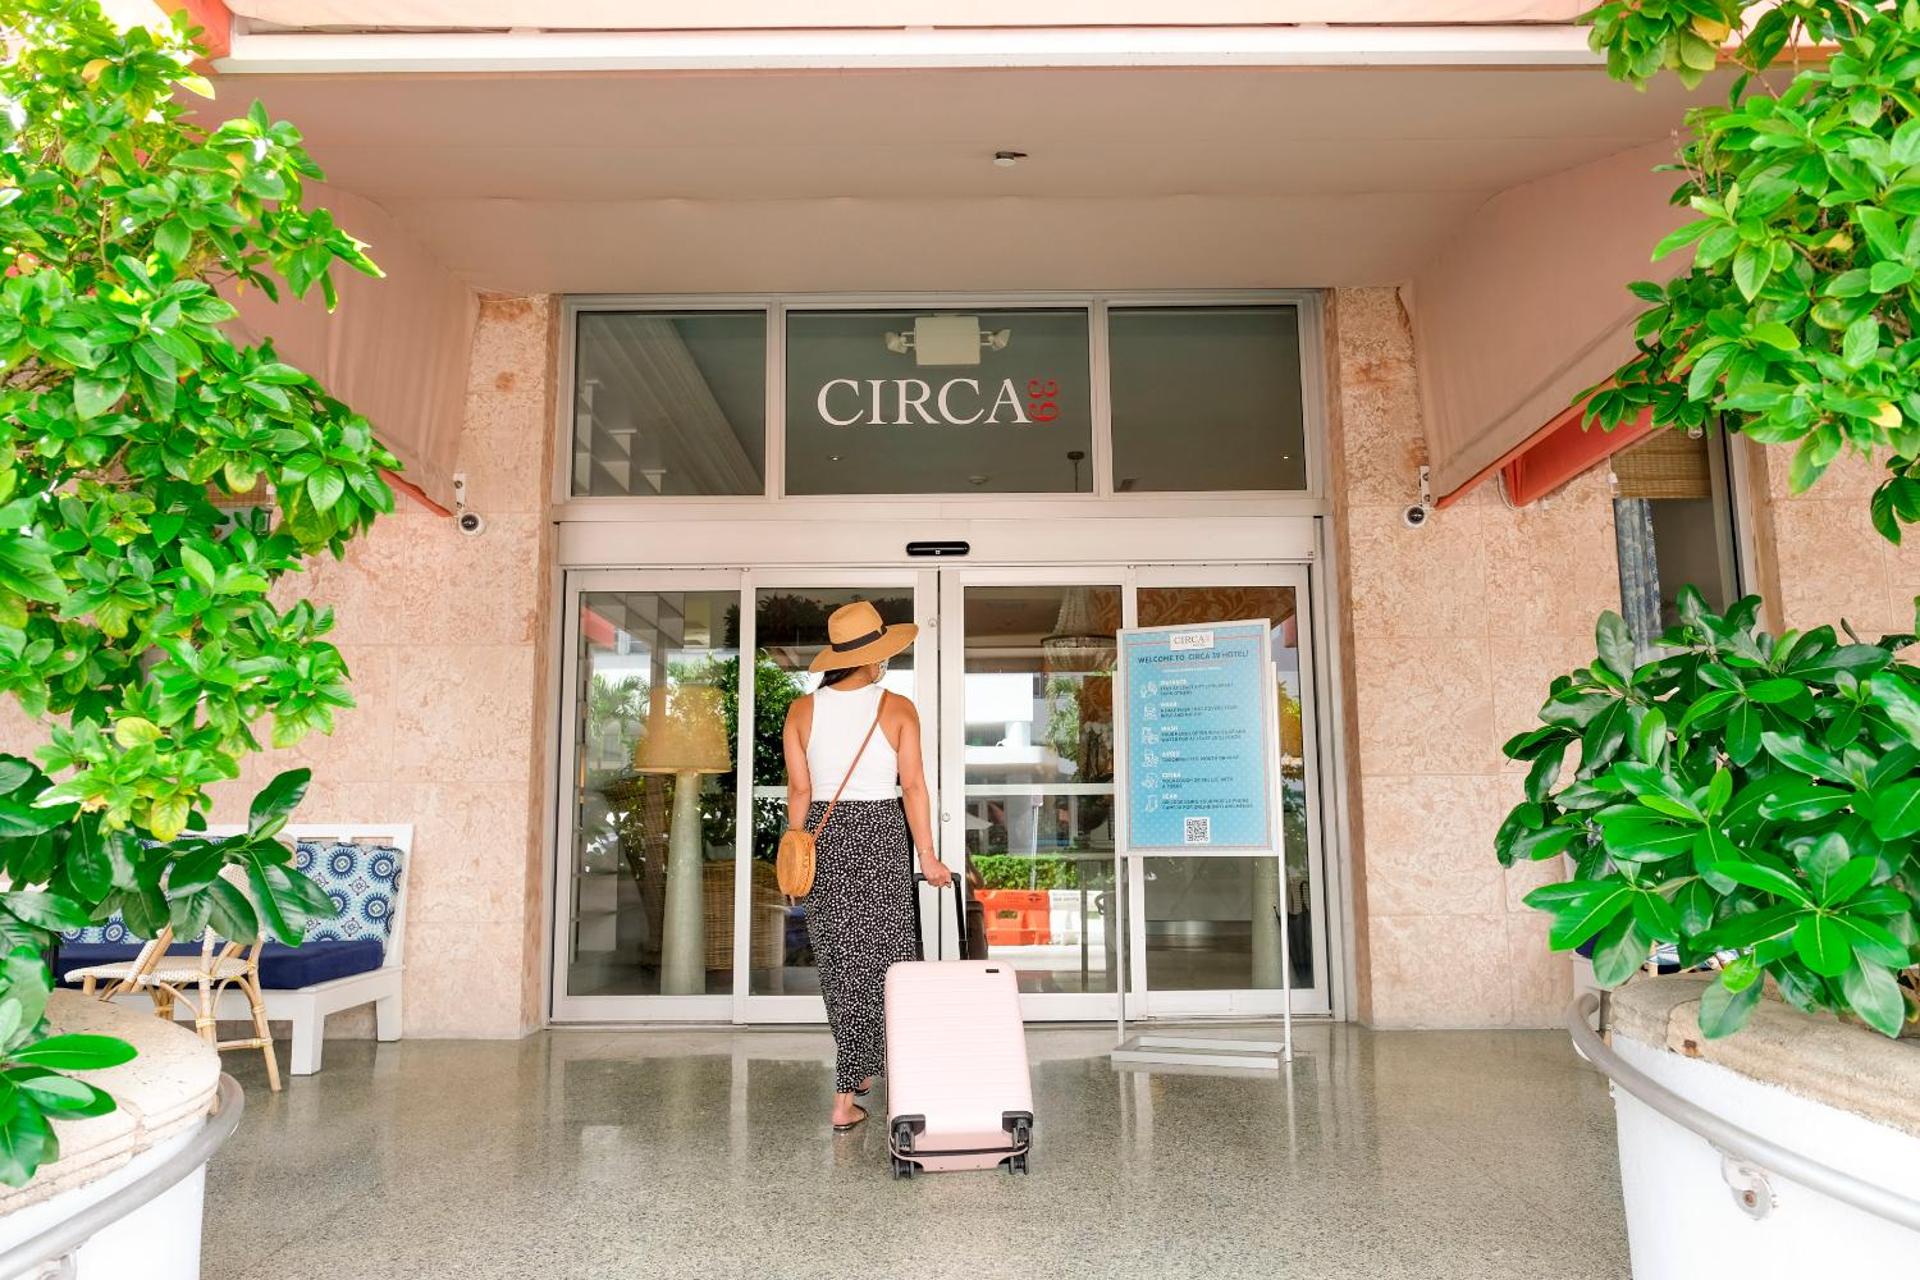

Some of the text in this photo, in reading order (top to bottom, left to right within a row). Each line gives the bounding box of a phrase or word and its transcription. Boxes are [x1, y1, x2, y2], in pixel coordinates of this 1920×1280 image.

[817, 377, 1060, 425] CIRCA 39
[1174, 634, 1206, 645] CIRCA
[1137, 655, 1174, 664] WELCOME
[1174, 654, 1185, 662] TO
[1187, 653, 1210, 661] CIRCA
